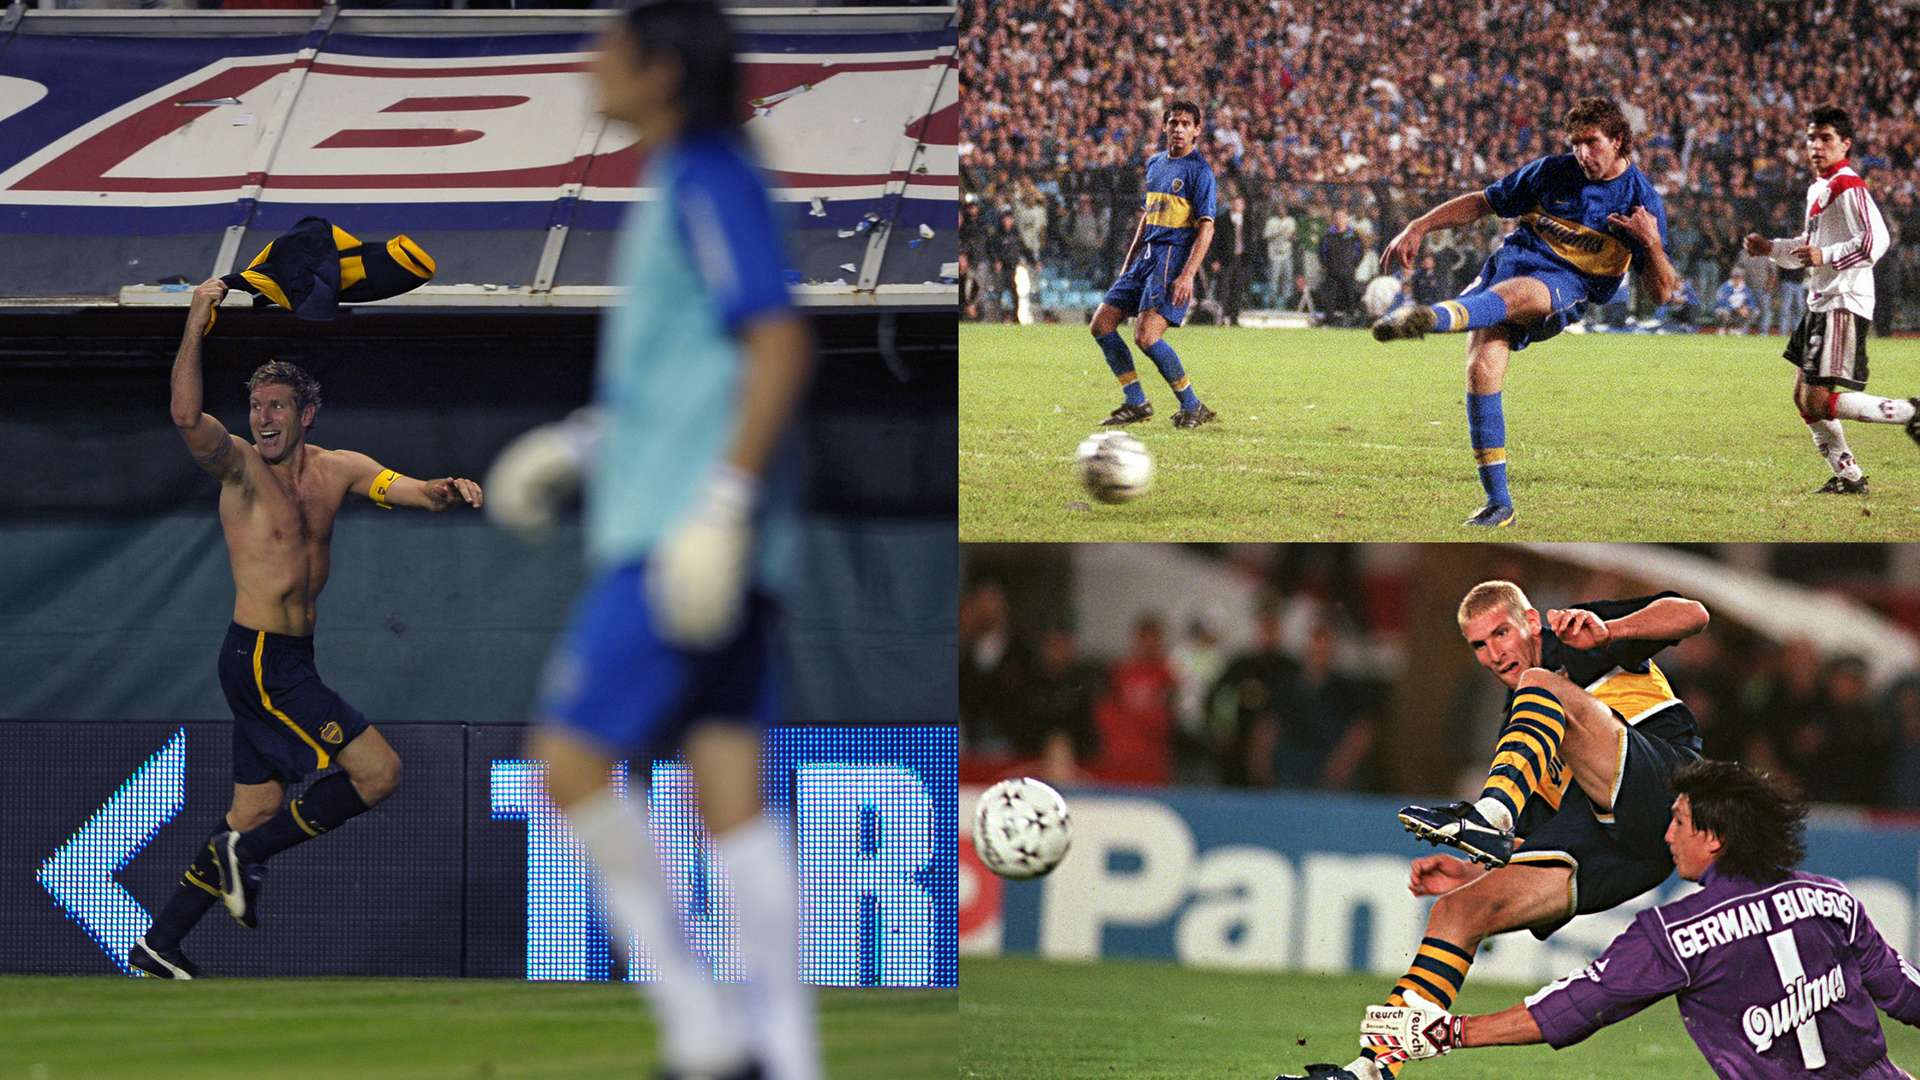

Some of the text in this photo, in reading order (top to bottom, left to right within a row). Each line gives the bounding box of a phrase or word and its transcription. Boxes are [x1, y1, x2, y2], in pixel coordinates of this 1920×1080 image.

[1671, 887, 1854, 959] GERMAN BURGOS
[1370, 1009, 1404, 1019] reusch
[1411, 1011, 1424, 1053] reusch
[1742, 963, 1847, 1054] Quilmes
[1767, 928, 1827, 1070] 1
